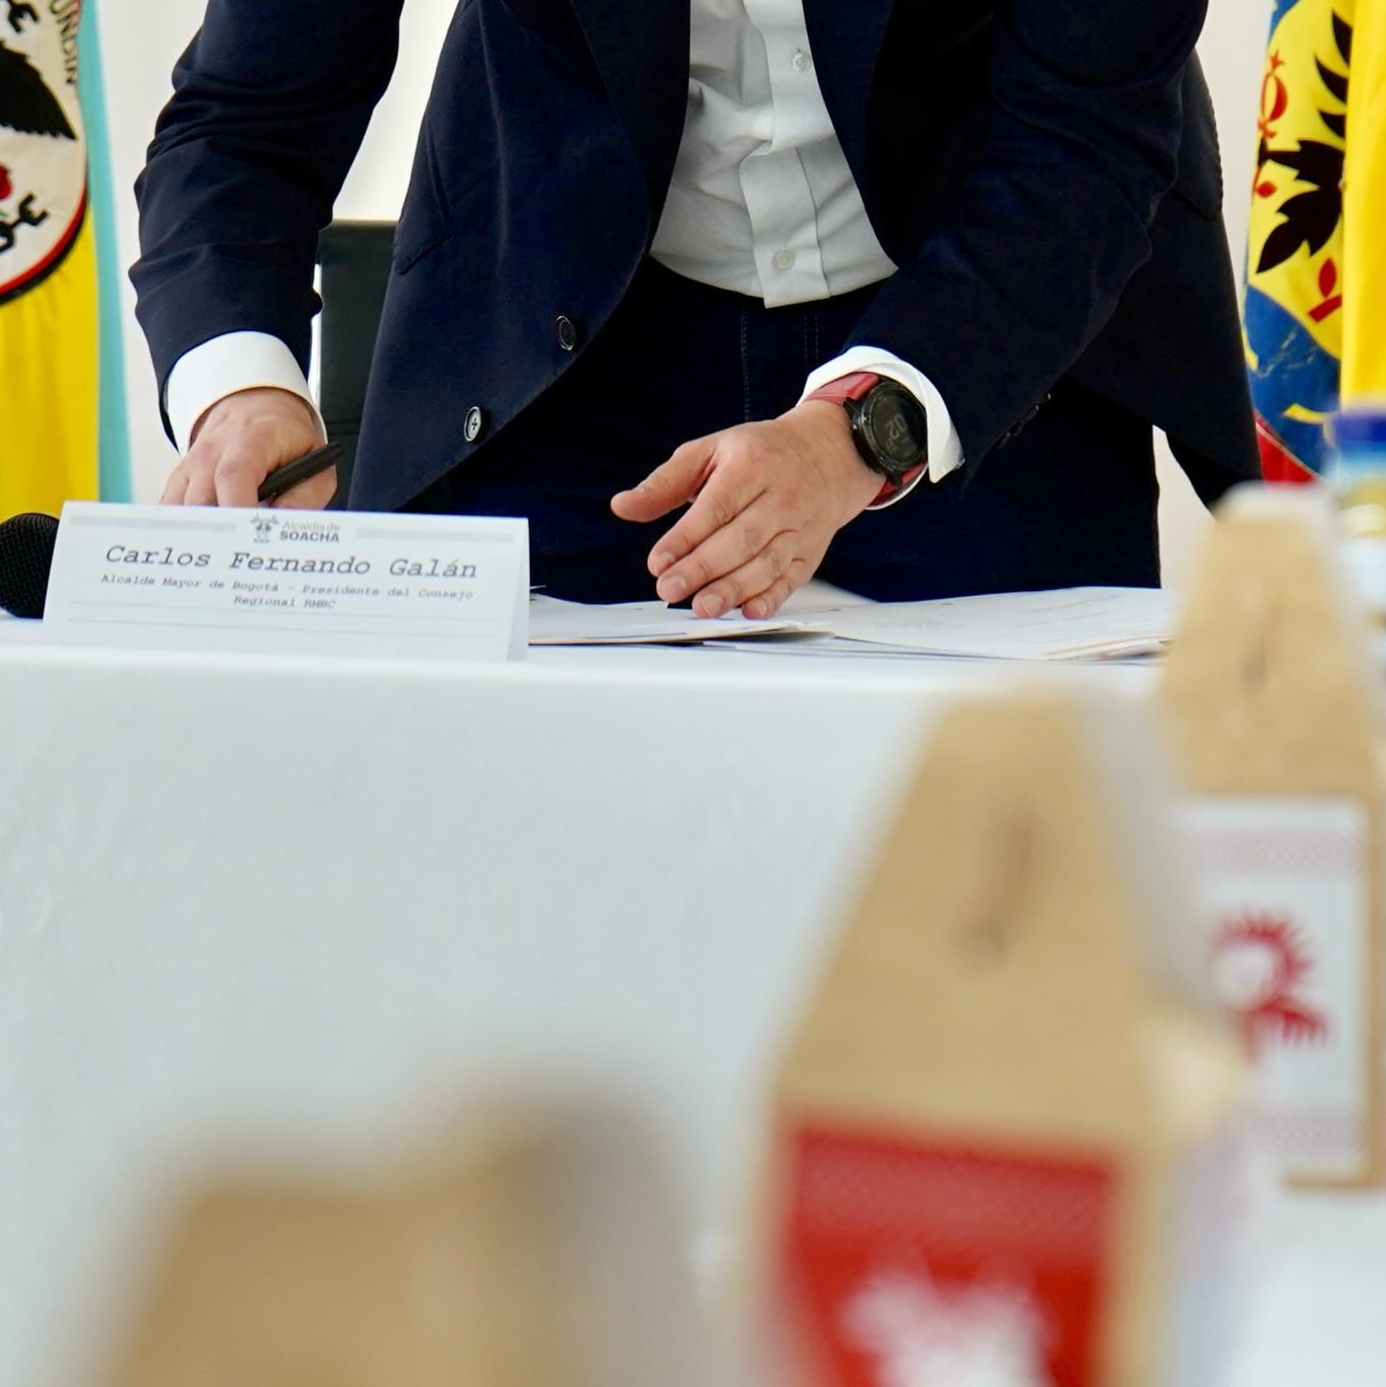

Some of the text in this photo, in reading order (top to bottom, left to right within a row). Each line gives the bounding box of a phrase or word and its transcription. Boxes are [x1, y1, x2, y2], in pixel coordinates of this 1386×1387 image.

[279, 531, 341, 543] SOACHA
[105, 545, 478, 579] Carlos Fernando Galán
[100, 574, 156, 586] Alcalde
[162, 577, 203, 590] Mayor
[209, 579, 225, 589] de
[231, 580, 279, 593] Bogotá
[302, 584, 380, 597] Presidente
[387, 586, 410, 598] del
[418, 588, 474, 601] Consejo
[233, 596, 296, 608] Regional
